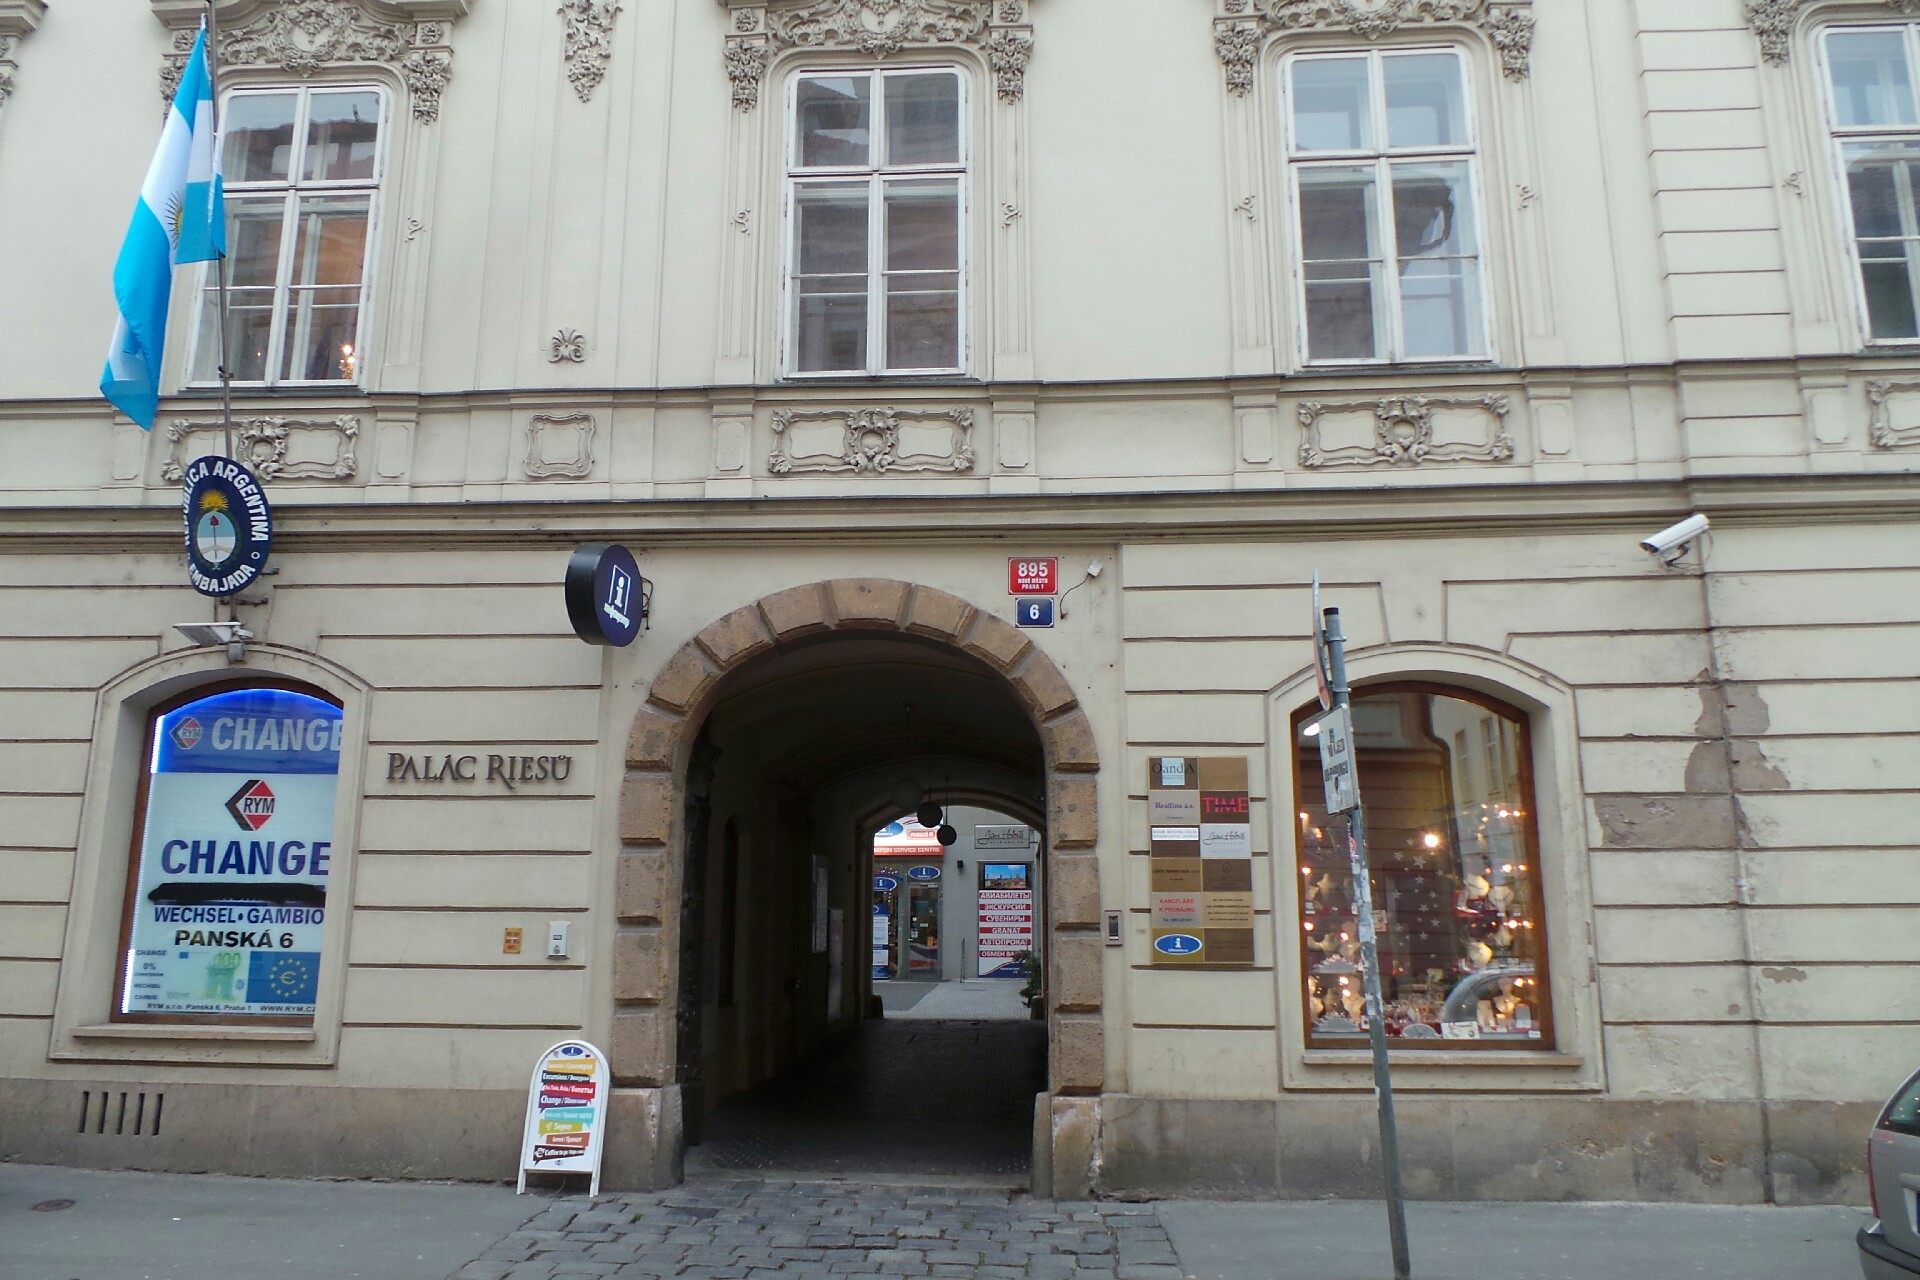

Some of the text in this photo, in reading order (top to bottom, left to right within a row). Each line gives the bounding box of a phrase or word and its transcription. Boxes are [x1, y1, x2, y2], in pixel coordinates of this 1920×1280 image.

[212, 461, 269, 541] ARGENTINA
[190, 564, 256, 592] EMBAJADA
[1018, 562, 1048, 577] 895
[1030, 605, 1040, 620] 6
[386, 753, 477, 780] PALÁC
[244, 798, 275, 814] RYM
[1201, 797, 1249, 813] TIME
[162, 840, 331, 875] CHANGE
[175, 929, 294, 949] PANSKÁ 6
[143, 962, 157, 970] 0%
